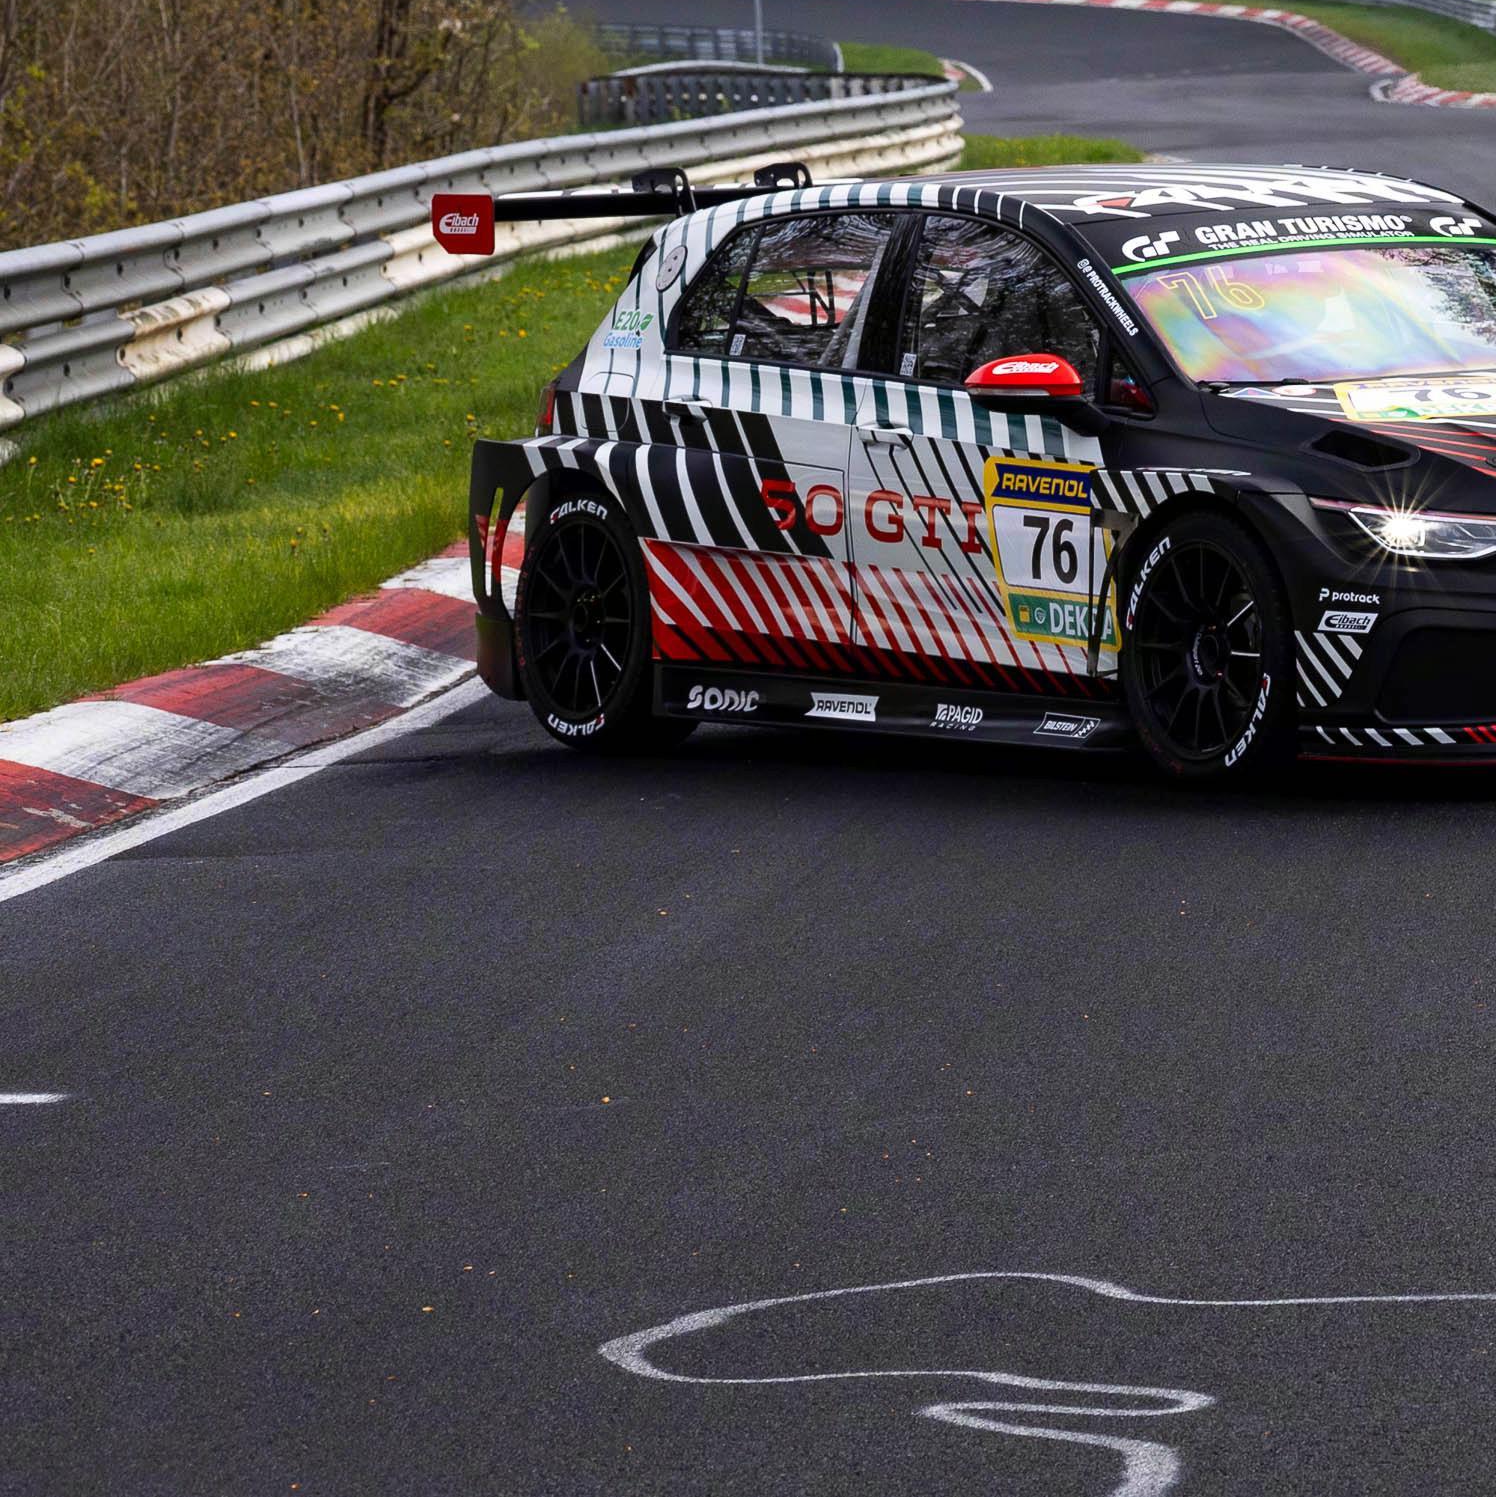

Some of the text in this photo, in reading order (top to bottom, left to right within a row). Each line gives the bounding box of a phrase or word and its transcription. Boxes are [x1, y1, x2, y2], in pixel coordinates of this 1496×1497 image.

[1195, 220, 1278, 244] GRAN
[1208, 231, 1415, 250] THE REAL DRIVING SIMULATOR
[1158, 265, 1265, 320] 76
[614, 311, 641, 331] E20
[603, 331, 643, 348] Gasoline
[1002, 472, 1088, 498] RAVENOL
[550, 499, 608, 524] FALKEN
[761, 479, 983, 554] 50 GTI
[1023, 516, 1079, 584] 76
[1126, 536, 1171, 631] FALKEN
[1332, 591, 1380, 604] protrack
[1325, 614, 1371, 630] Eibach
[816, 699, 871, 715] RAVENOL
[947, 705, 984, 725] PAGID
[548, 713, 605, 737] FALKEN
[1225, 672, 1271, 767] FALKEN
